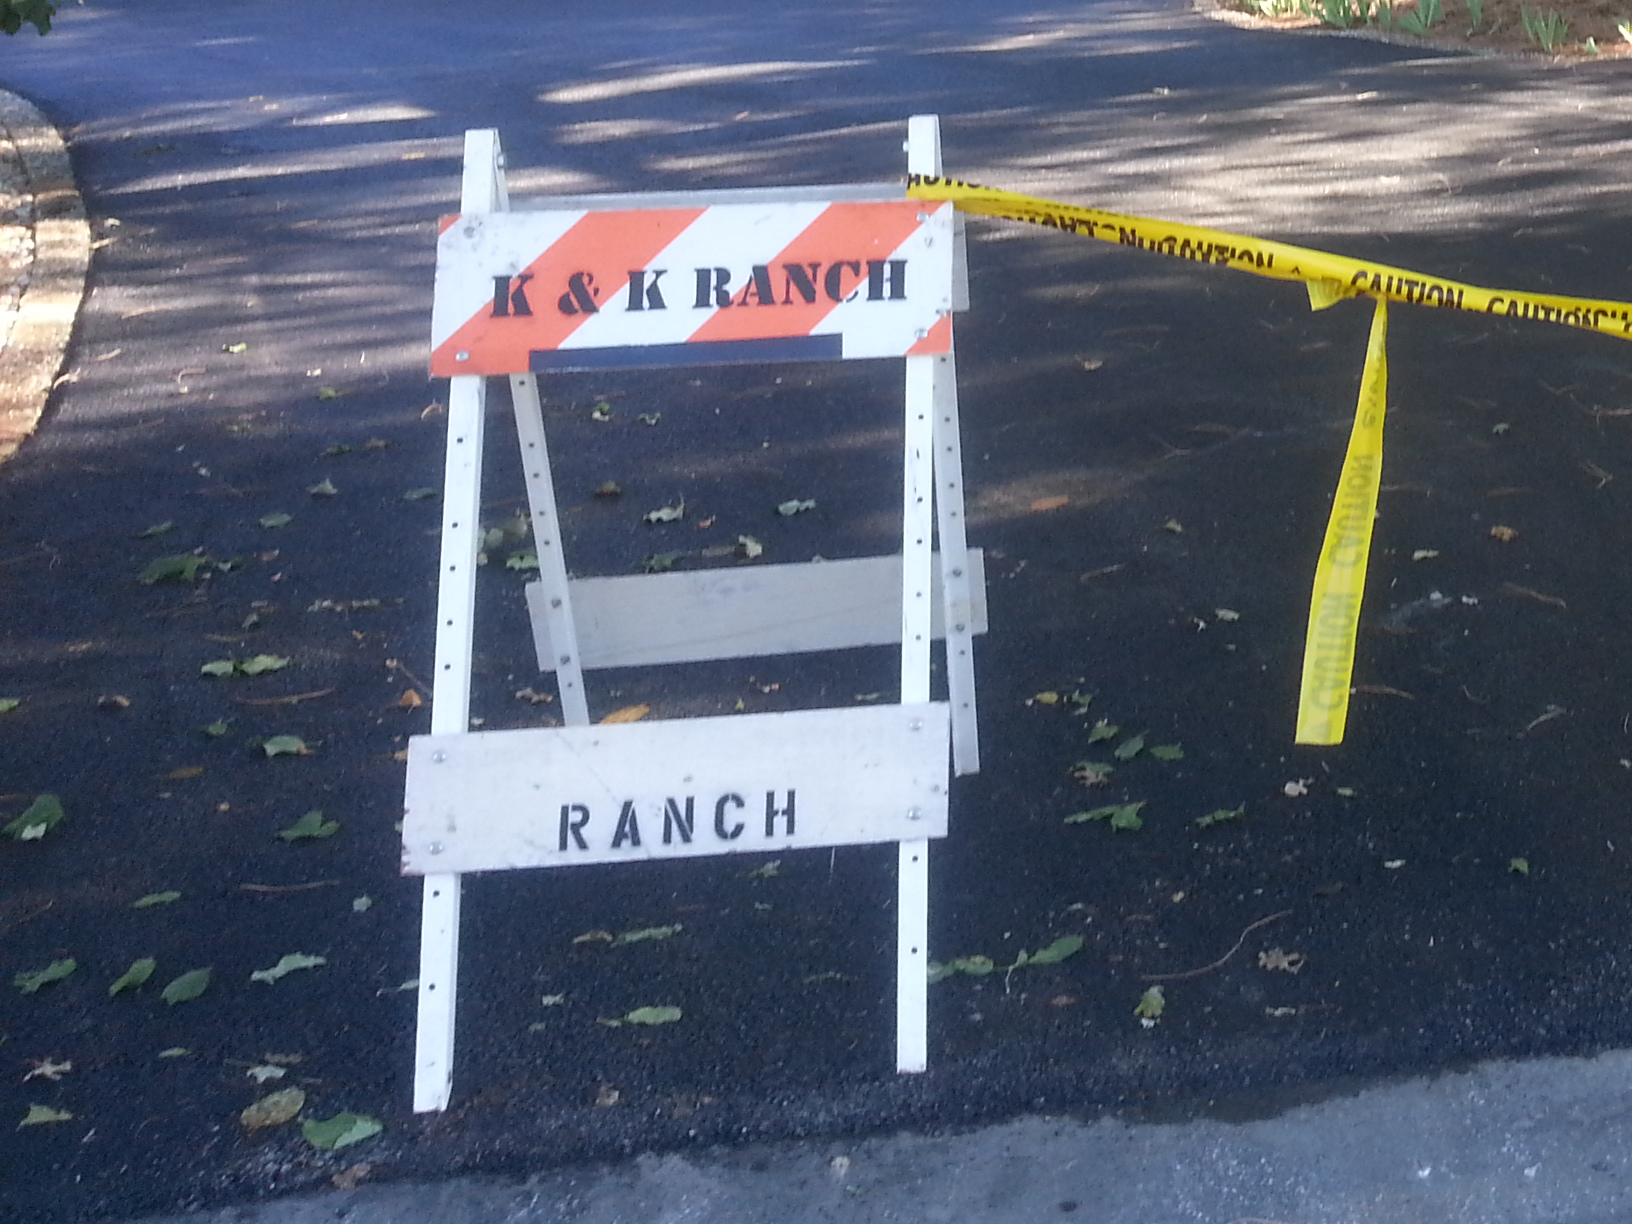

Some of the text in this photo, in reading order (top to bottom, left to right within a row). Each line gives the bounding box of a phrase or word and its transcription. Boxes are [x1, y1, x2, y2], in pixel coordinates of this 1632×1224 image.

[489, 259, 909, 318] K & K RANCH
[557, 789, 797, 852] RANCH
